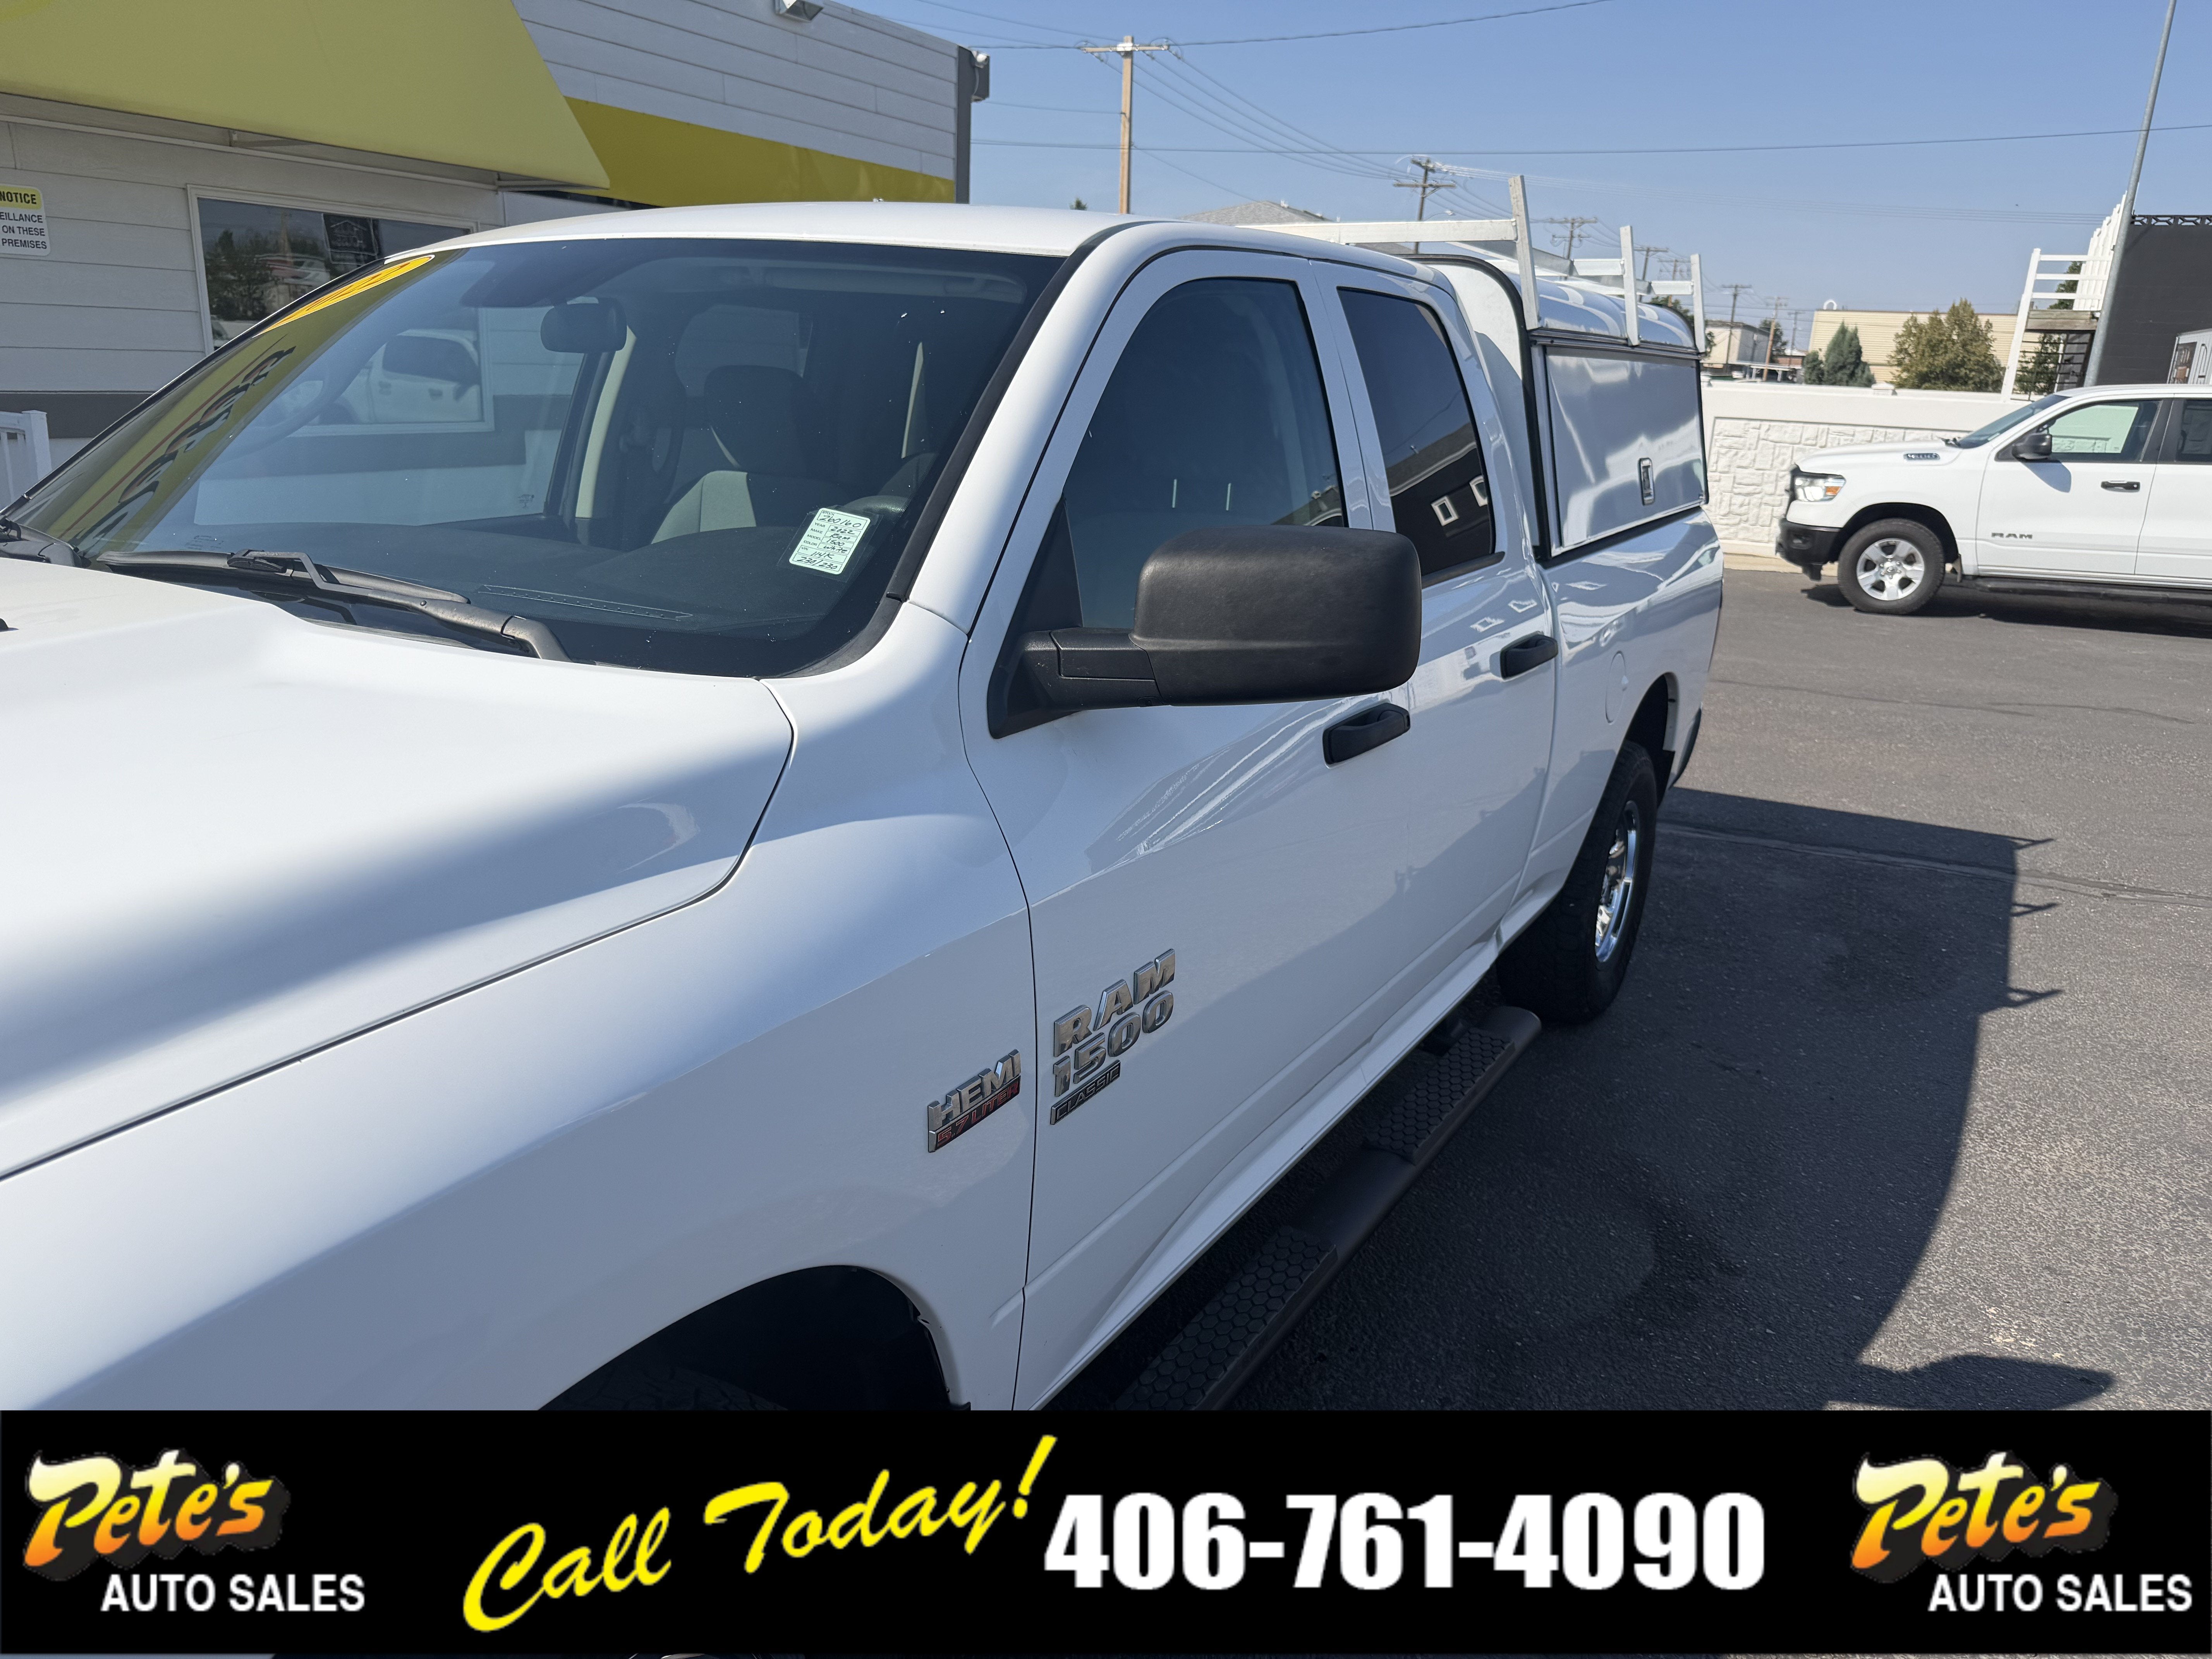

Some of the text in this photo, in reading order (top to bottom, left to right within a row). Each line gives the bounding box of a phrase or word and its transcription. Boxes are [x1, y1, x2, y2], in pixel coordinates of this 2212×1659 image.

[0, 191, 37, 204] NOTICE
[2, 225, 45, 236] ON THESE
[2, 238, 47, 249] PREMISES
[820, 515, 861, 527] 260160
[1053, 949, 1175, 1057] RAM
[1053, 990, 1174, 1097] 1500
[928, 1049, 1021, 1130] HEMI
[938, 1082, 1018, 1147] 5.7 LITER
[1057, 1065, 1120, 1120] CLASSIC
